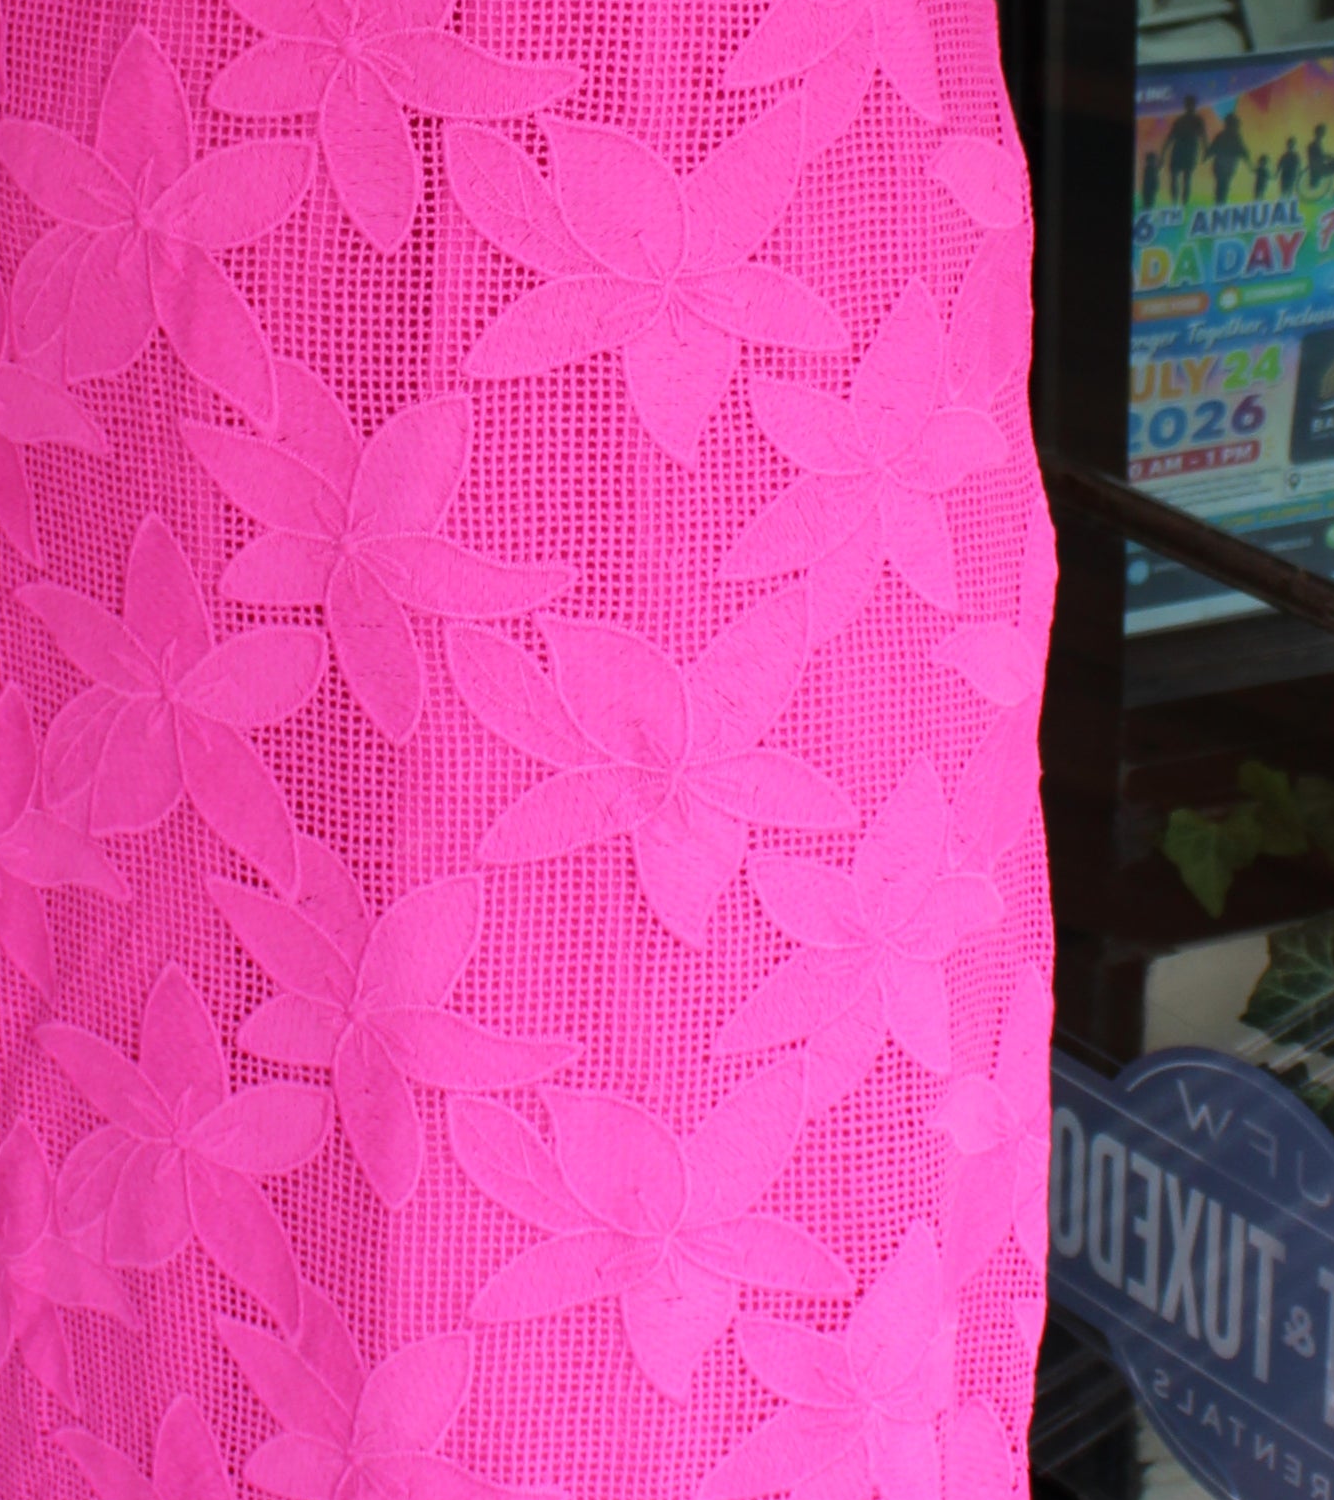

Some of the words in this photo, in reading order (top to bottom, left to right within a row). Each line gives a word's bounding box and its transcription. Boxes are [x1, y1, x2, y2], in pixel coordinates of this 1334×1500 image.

[1134, 206, 1183, 244] 6TH
[1189, 199, 1304, 236] ANNUAL
[1134, 245, 1202, 290] DA
[1216, 231, 1306, 282] DAY
[1131, 357, 1218, 402] ULY
[1222, 345, 1283, 390] 24
[1148, 455, 1183, 476] AM
[1205, 451, 1216, 466] 1
[1222, 444, 1253, 463] PM
